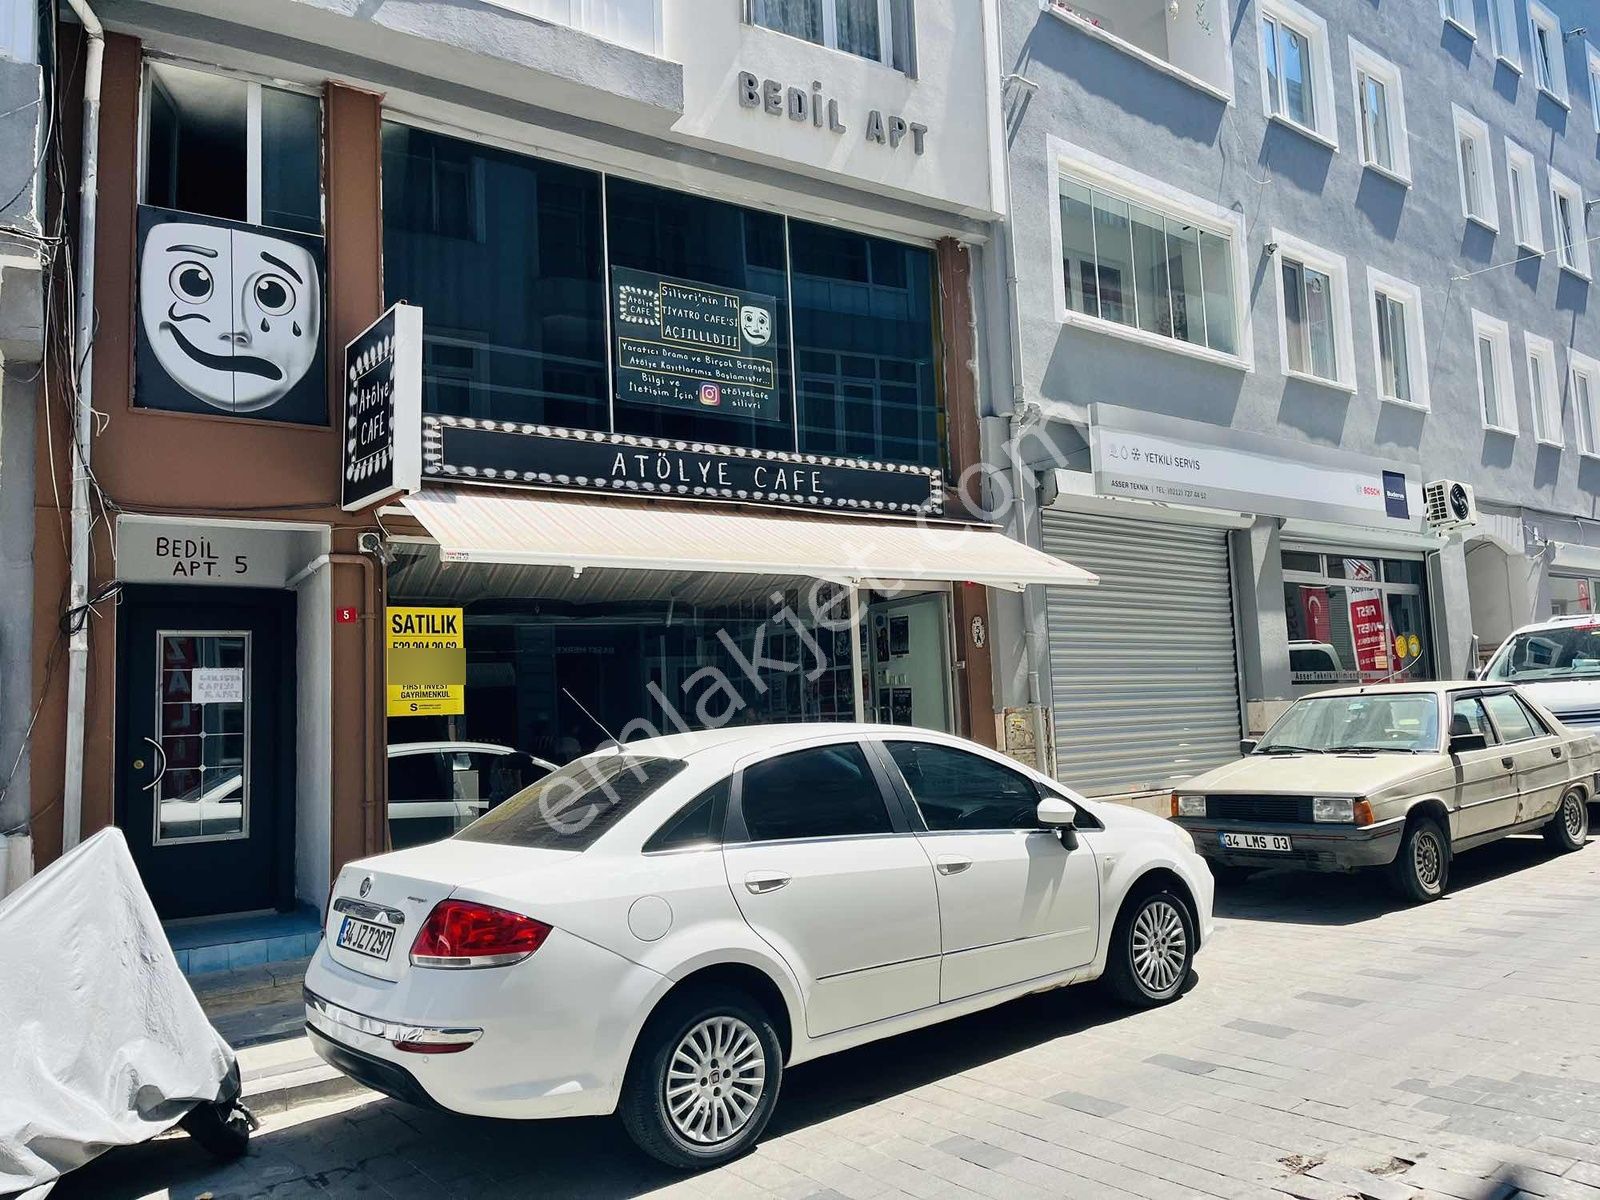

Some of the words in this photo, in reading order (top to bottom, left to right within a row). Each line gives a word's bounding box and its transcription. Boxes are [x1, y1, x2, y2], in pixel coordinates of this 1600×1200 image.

[738, 70, 847, 135] BEDİL
[865, 109, 928, 156] APT
[630, 305, 651, 316] CAFE
[662, 348, 689, 360] Drama
[641, 372, 665, 387] Bilgi
[359, 379, 390, 415] Atölye
[732, 400, 761, 409] silivri
[361, 410, 385, 446] CAFE
[611, 452, 732, 486] ATÖLYE
[754, 466, 824, 493] CAFE
[1111, 480, 1129, 489] ASSER
[156, 536, 219, 559] BEDİL
[172, 561, 221, 577] APT.
[235, 555, 248, 574] 5
[343, 610, 350, 620] 5
[391, 613, 458, 635] SATILIK
[1225, 834, 1240, 847] 34
[1245, 835, 1267, 849] LMS
[1273, 837, 1289, 850] 03
